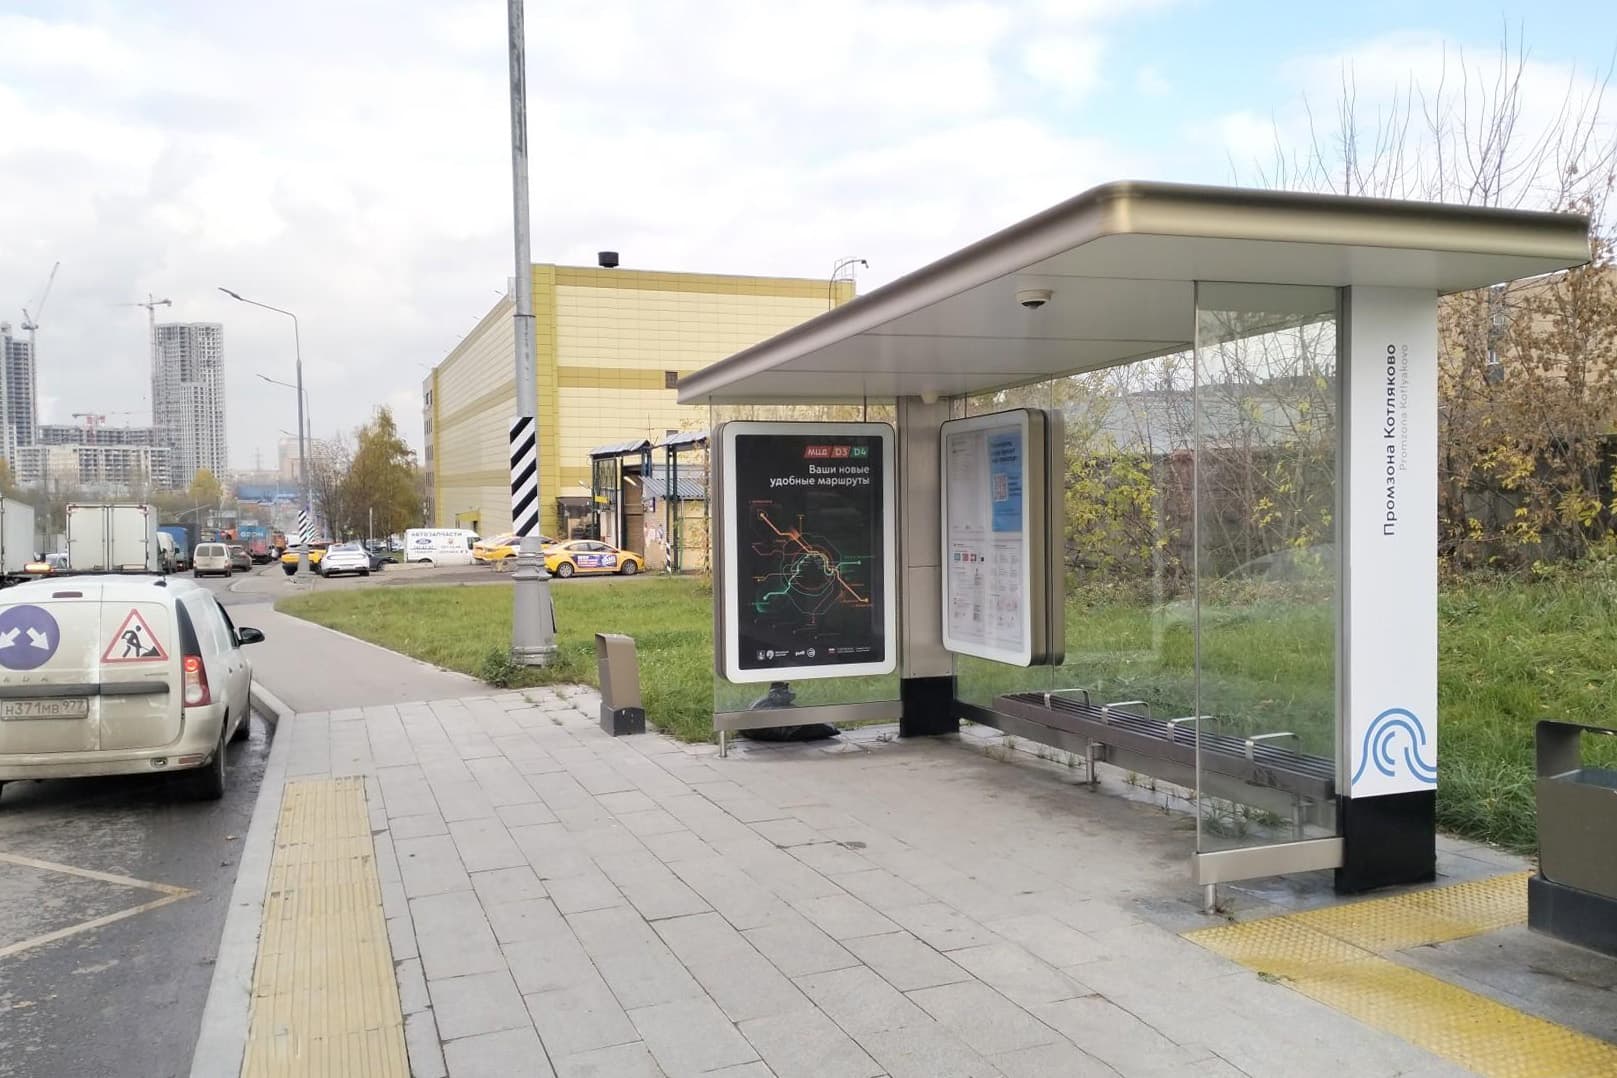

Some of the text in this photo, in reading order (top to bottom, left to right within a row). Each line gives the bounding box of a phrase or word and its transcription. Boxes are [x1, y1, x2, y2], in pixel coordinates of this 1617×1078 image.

[1384, 344, 1397, 535] Промзона Котляково
[1400, 344, 1408, 471] Promzona Kotlyakovo
[770, 475, 870, 487] удобные маршруты
[809, 464, 870, 474] Ваши новые
